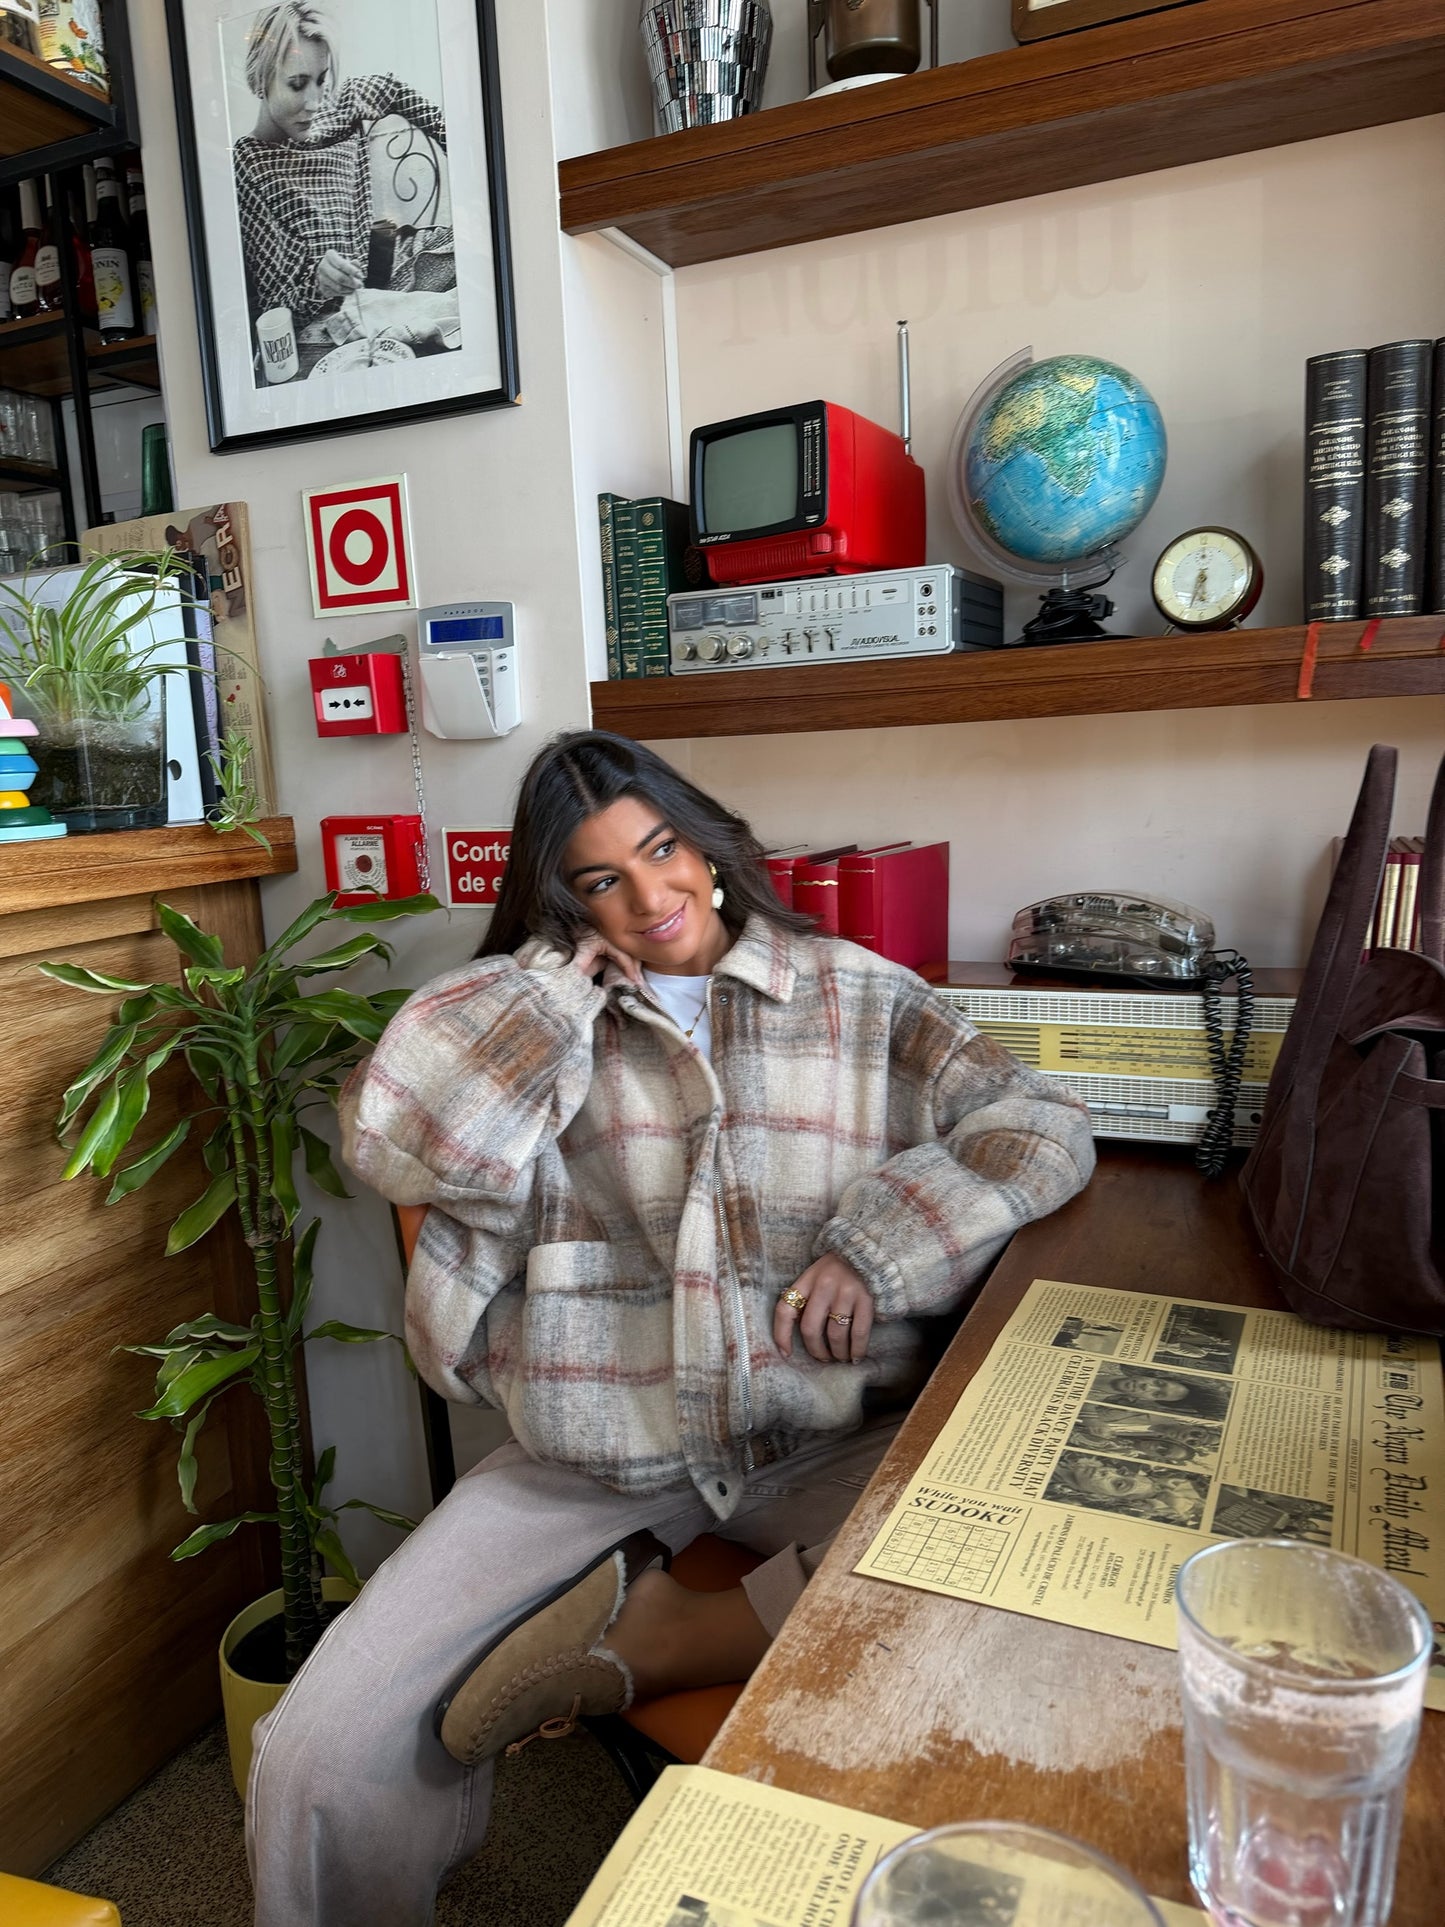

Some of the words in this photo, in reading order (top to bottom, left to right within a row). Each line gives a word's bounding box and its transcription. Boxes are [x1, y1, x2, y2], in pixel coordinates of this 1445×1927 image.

[213, 503, 247, 618] NEGRA
[452, 840, 511, 862] Corte
[457, 871, 486, 892] de
[1050, 1354, 1083, 1405] CELEBRATES
[1066, 1366, 1095, 1402] DAYTIME
[1033, 1404, 1059, 1436] BLACK
[1051, 1403, 1077, 1434] DANCE
[1372, 1393, 1424, 1420] The
[1036, 1437, 1062, 1468] PARTY
[1370, 1419, 1425, 1465] Negra
[1008, 1436, 1044, 1490] DIVERSITY
[917, 1486, 958, 1500] While
[959, 1495, 988, 1508] you
[989, 1504, 1023, 1514] wait
[1022, 1471, 1048, 1499] THAT
[1369, 1467, 1428, 1519] Daily
[907, 1496, 1019, 1526] SUDOKU
[1059, 1514, 1076, 1536] JARDINS
[1046, 1545, 1064, 1571] PALÁCIO
[1368, 1518, 1430, 1578] Meal
[1107, 1555, 1124, 1587] CLÉRIGOS
[1032, 1580, 1050, 1606] CRISTAL
[825, 1832, 850, 1869] ONDE
[838, 1837, 869, 1882] PORTO
[828, 1894, 841, 1904] A
[833, 1883, 851, 1895] É
